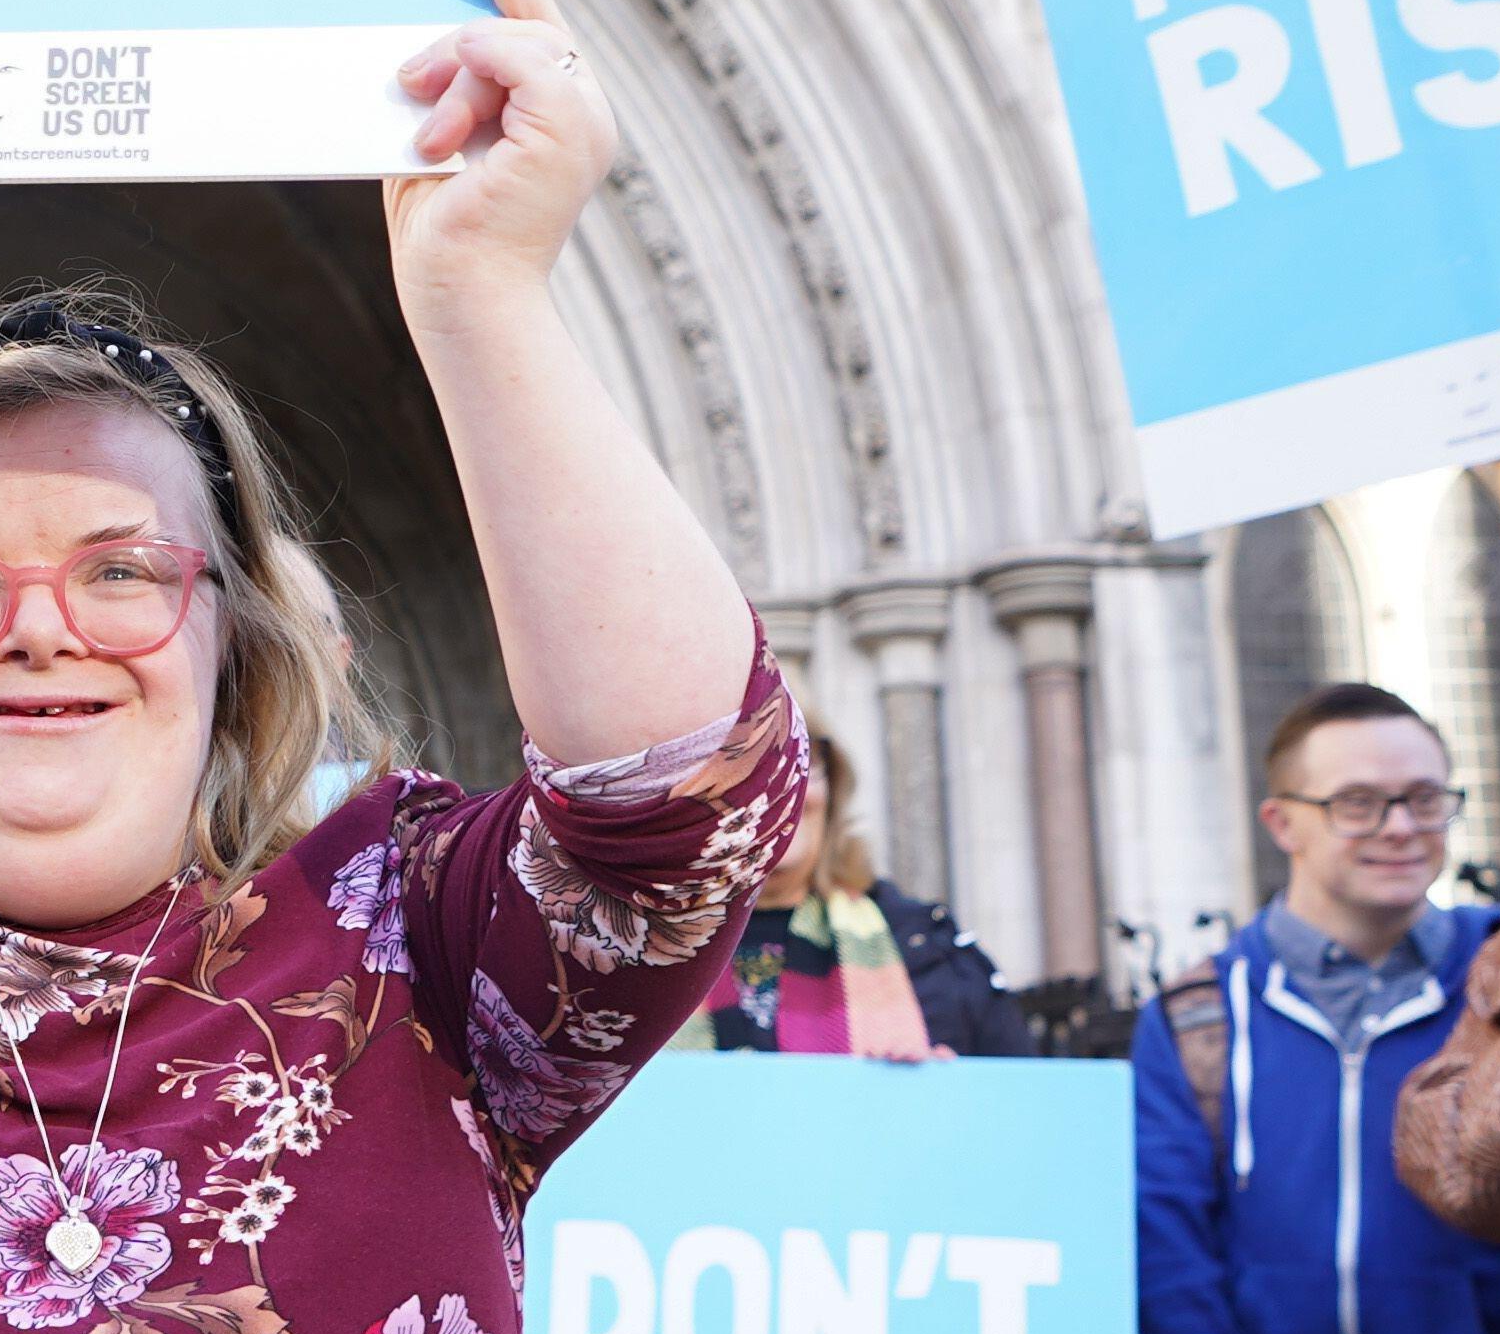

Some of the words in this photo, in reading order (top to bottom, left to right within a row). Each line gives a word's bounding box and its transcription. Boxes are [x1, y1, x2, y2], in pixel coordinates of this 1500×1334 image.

[47, 46, 152, 79] DON'T
[45, 81, 151, 105] SCREEN
[42, 110, 83, 136] US
[94, 109, 150, 135] OUT
